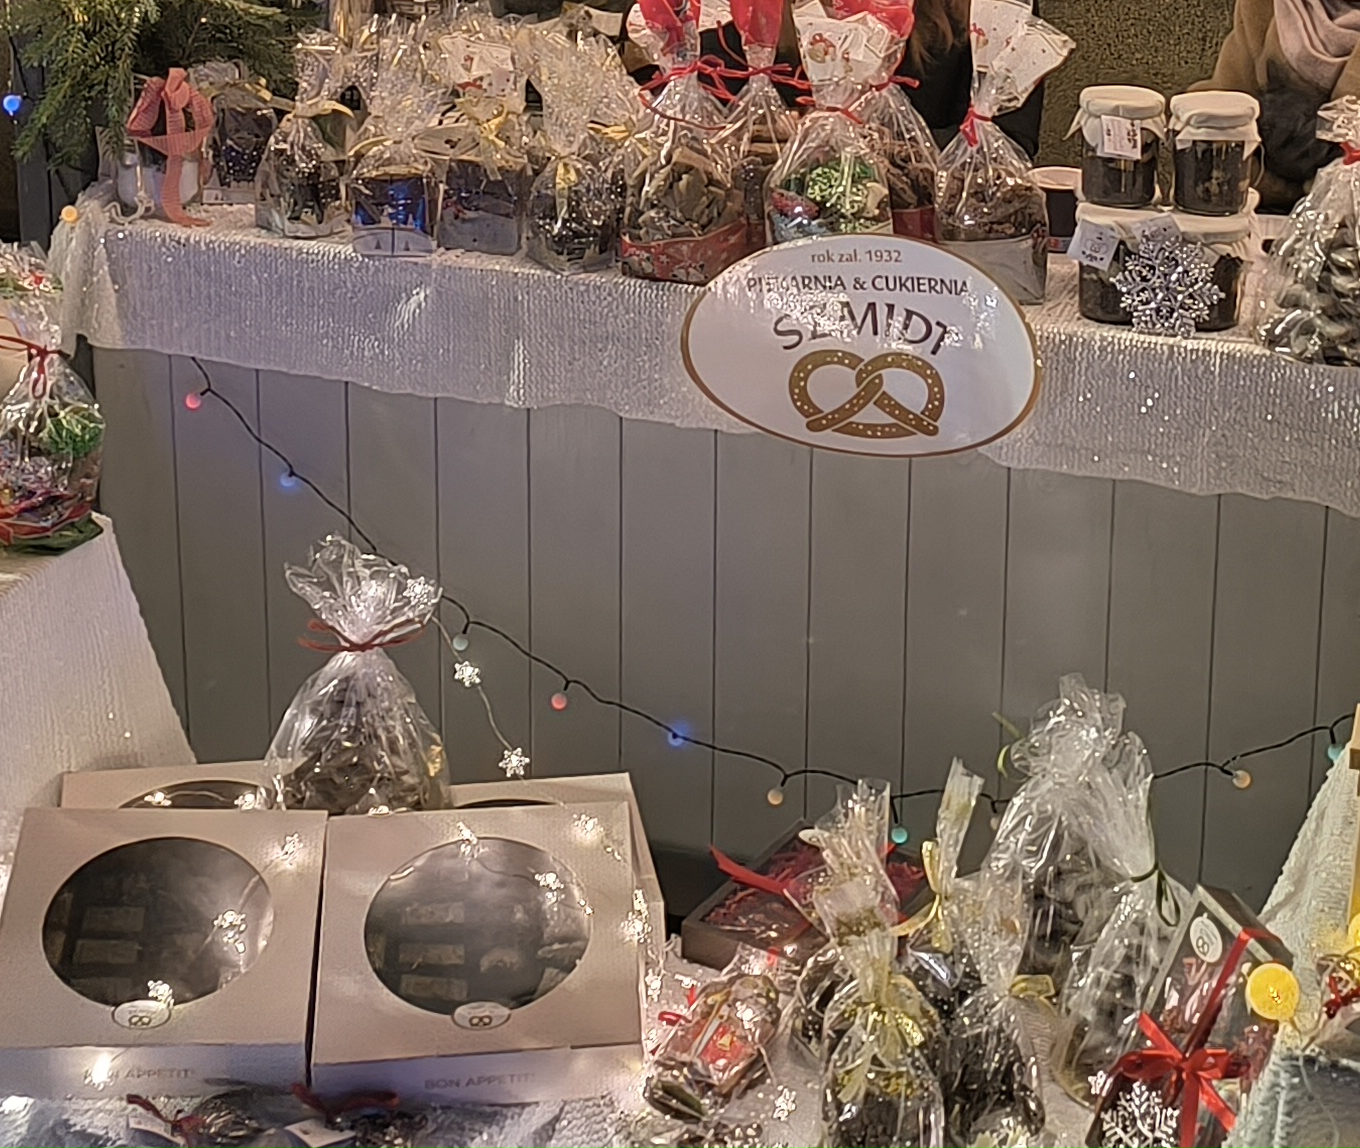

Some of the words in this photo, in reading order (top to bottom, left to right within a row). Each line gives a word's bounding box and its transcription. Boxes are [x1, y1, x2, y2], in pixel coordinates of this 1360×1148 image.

[811, 249, 835, 263] rok
[865, 249, 902, 263] 1932
[853, 276, 868, 290] &
[871, 274, 968, 296] CUKIERNIA
[424, 1078, 460, 1090] BON
